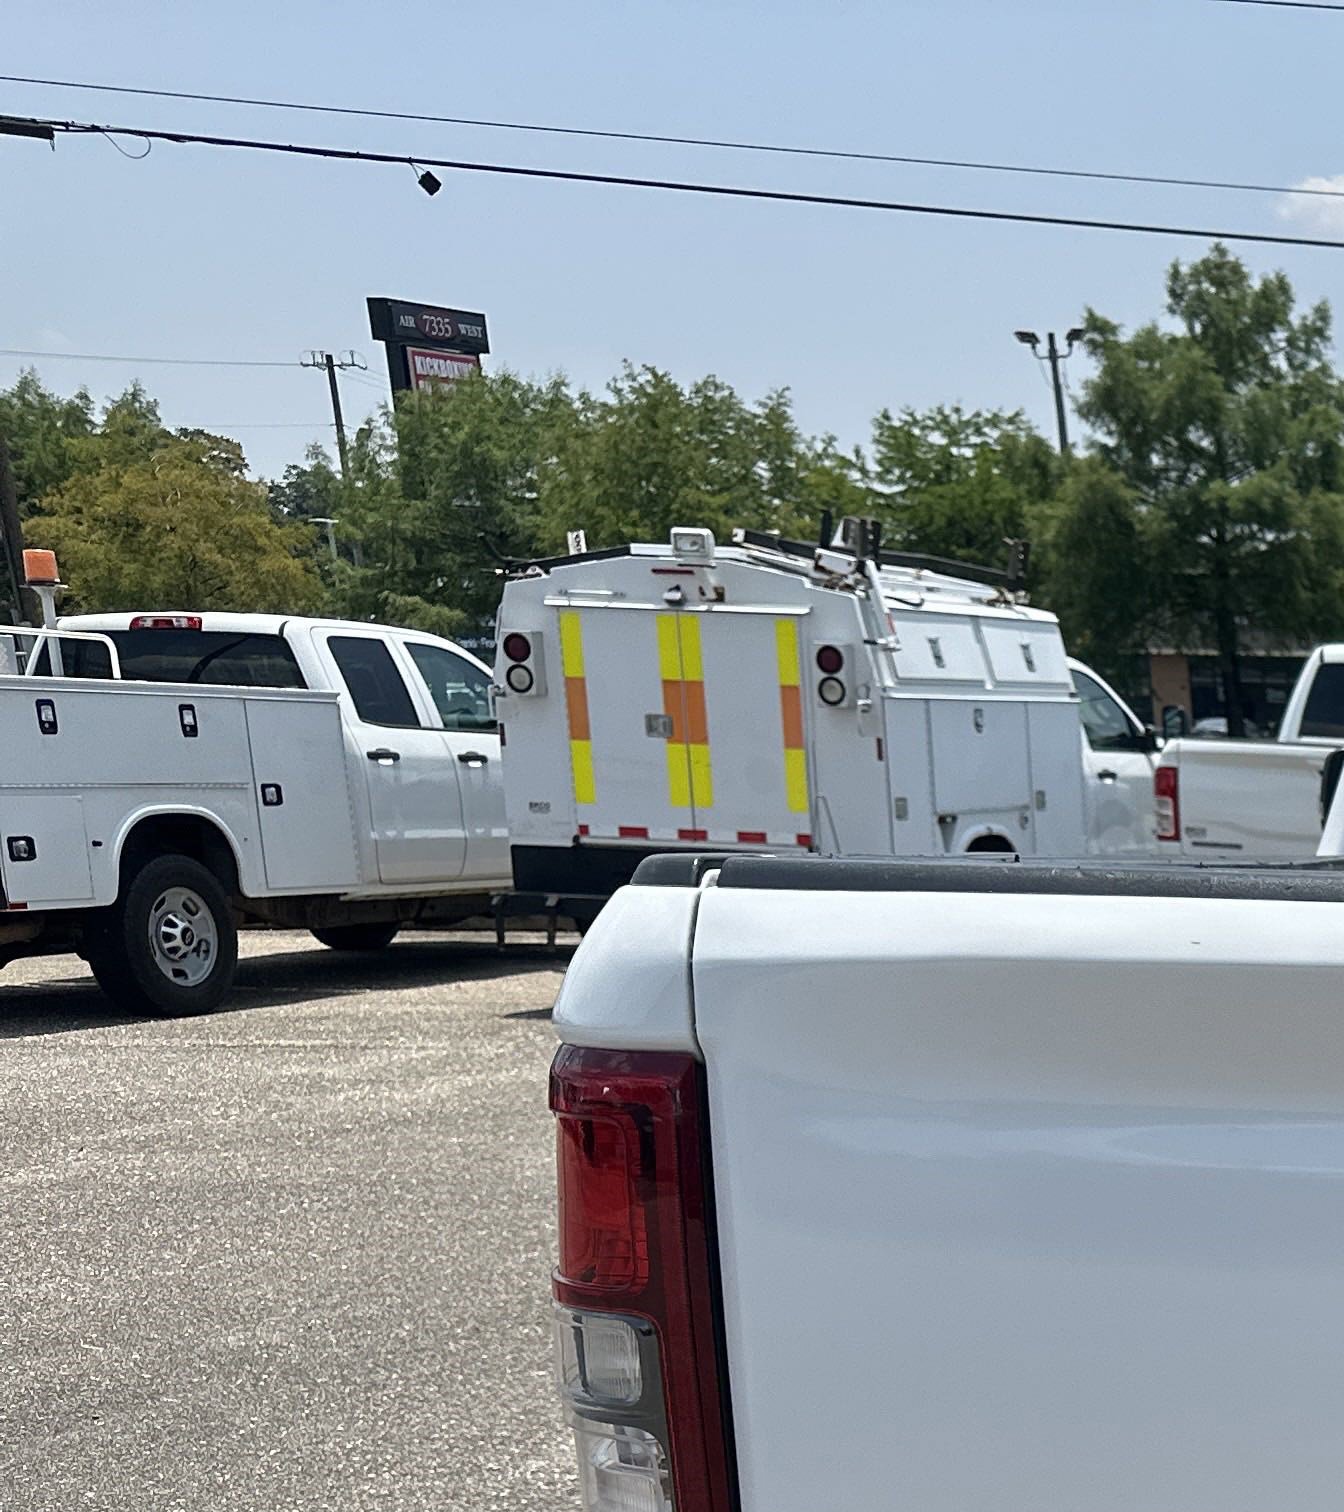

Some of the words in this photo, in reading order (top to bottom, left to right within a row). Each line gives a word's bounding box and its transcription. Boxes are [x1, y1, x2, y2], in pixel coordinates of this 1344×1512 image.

[400, 315, 416, 328] AIR
[422, 314, 452, 337] 7335
[458, 323, 483, 338] WEST
